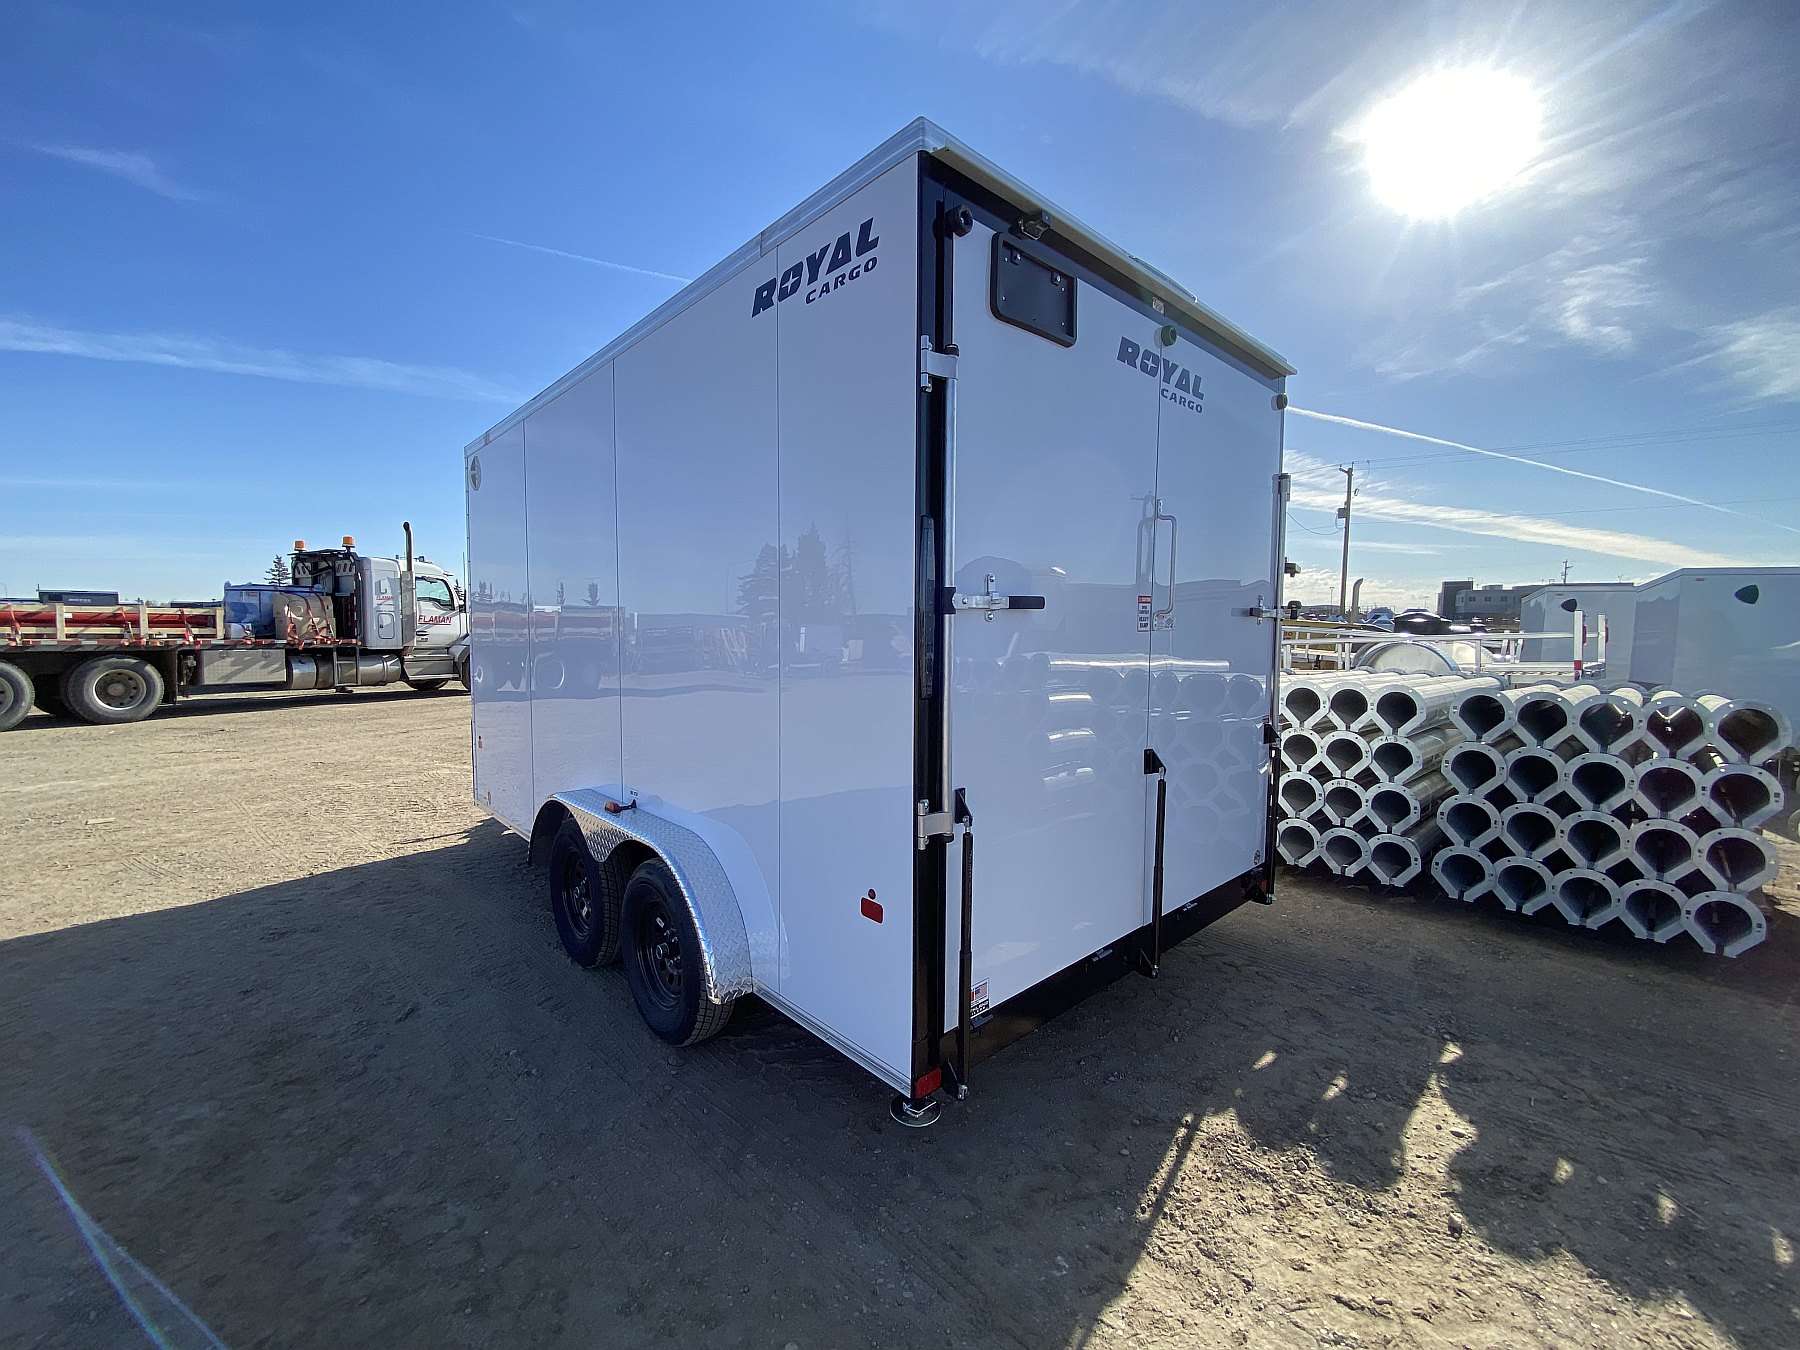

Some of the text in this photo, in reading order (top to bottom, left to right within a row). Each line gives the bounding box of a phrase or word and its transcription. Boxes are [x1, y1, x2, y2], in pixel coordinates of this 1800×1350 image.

[752, 217, 880, 318] ROYAL
[805, 256, 878, 304] CARGO
[1117, 336, 1205, 400] ROYAL
[1160, 388, 1203, 413] CARGO
[418, 615, 452, 623] FLAMAN
